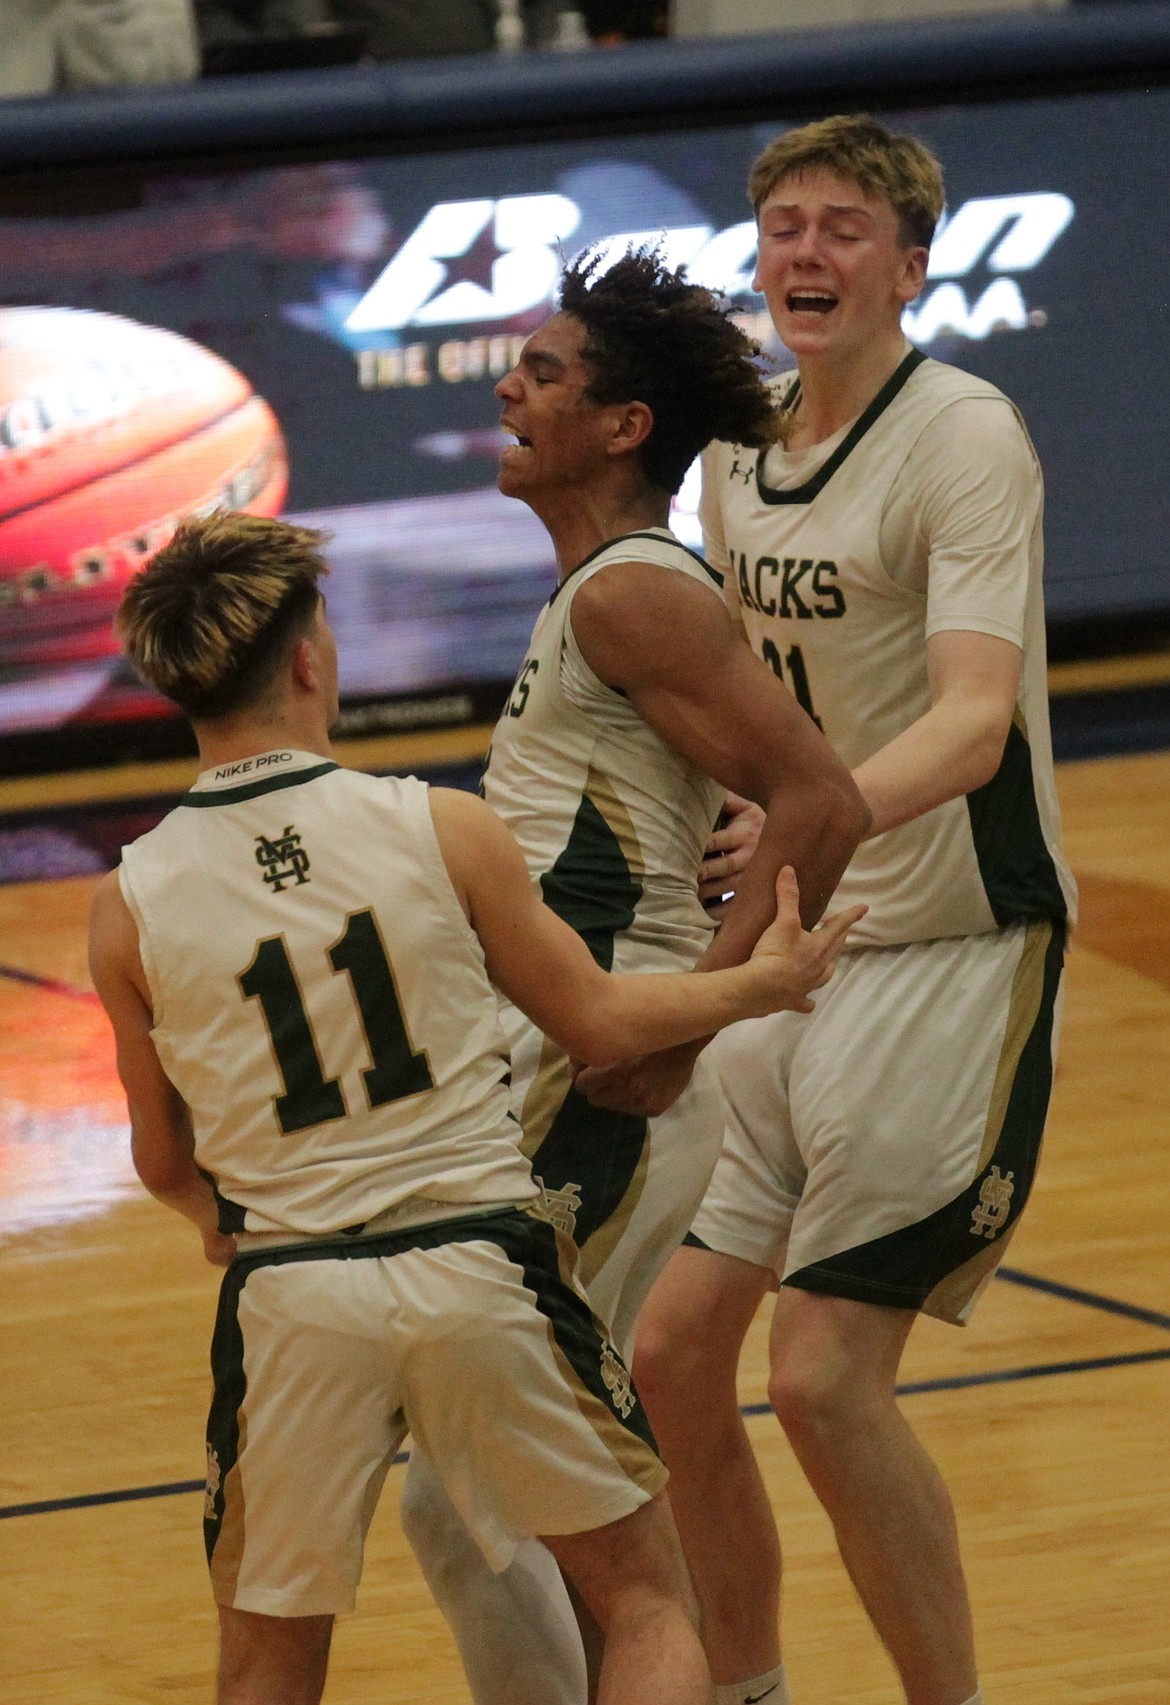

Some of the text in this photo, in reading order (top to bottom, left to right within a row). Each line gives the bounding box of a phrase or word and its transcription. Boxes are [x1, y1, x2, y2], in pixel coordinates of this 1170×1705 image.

[730, 549, 847, 620] ACKS
[215, 753, 292, 780] NIKE PRO
[234, 904, 438, 1138] 11
